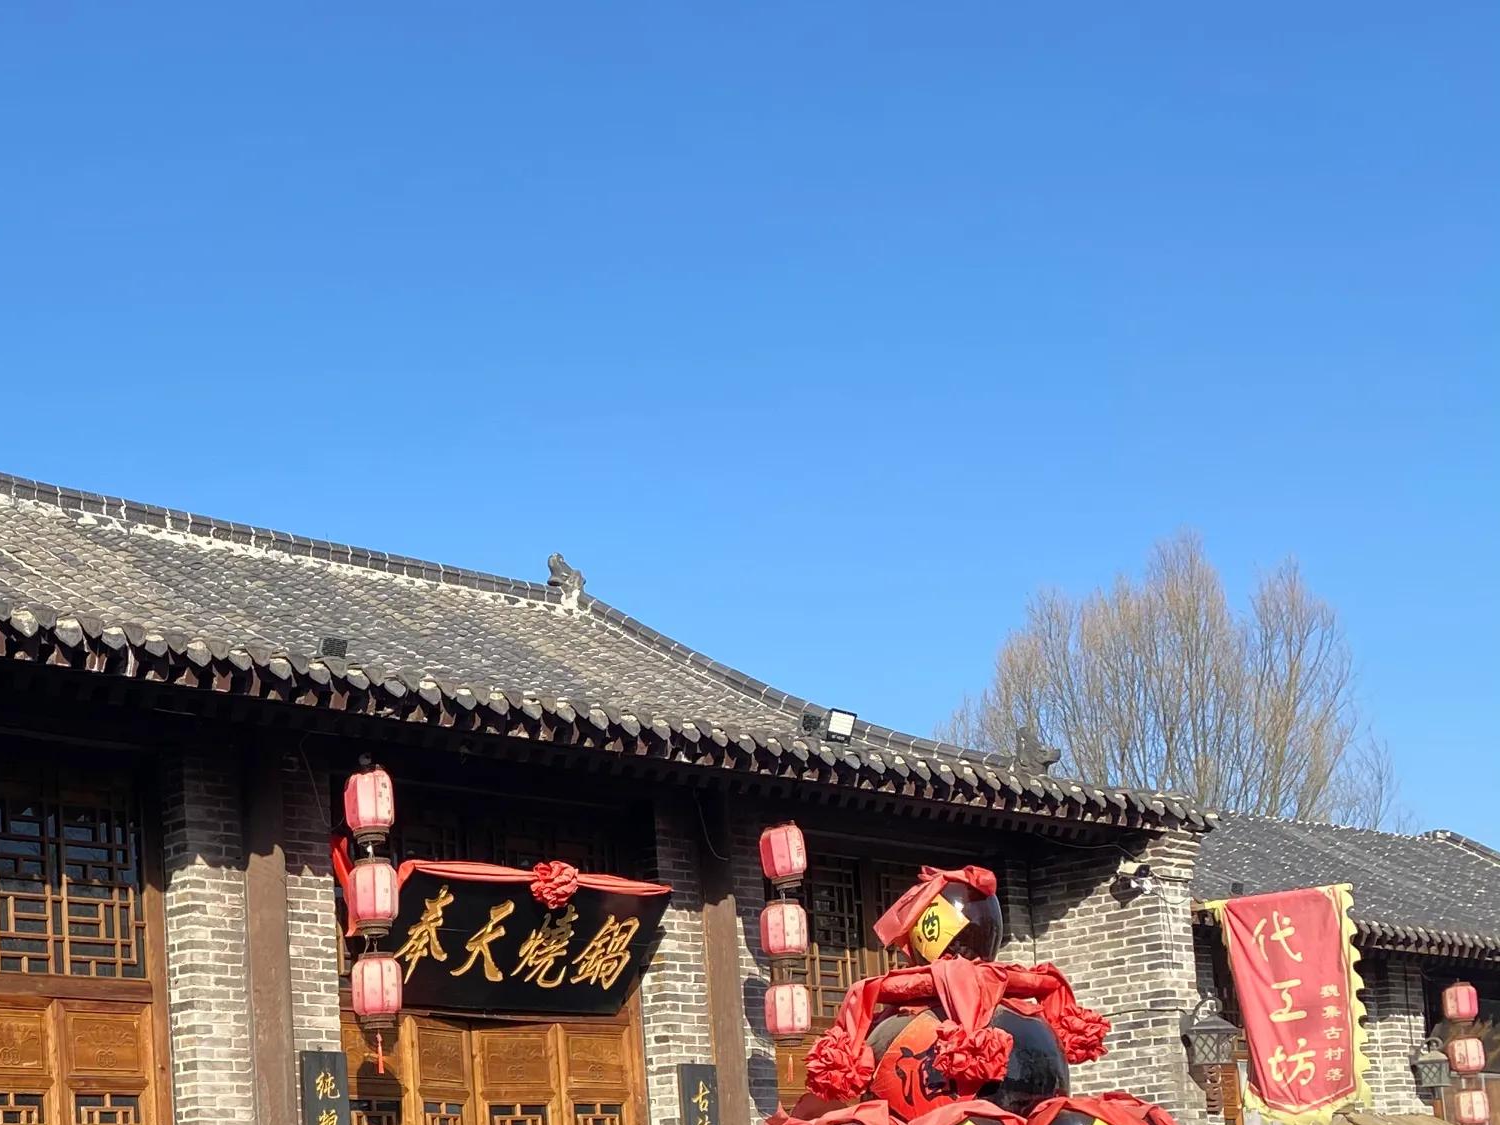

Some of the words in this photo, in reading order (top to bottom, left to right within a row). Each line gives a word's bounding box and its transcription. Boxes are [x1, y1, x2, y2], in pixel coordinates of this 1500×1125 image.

[393, 885, 641, 990] 奉天燒鍋
[1251, 910, 1317, 1088] 代工坊
